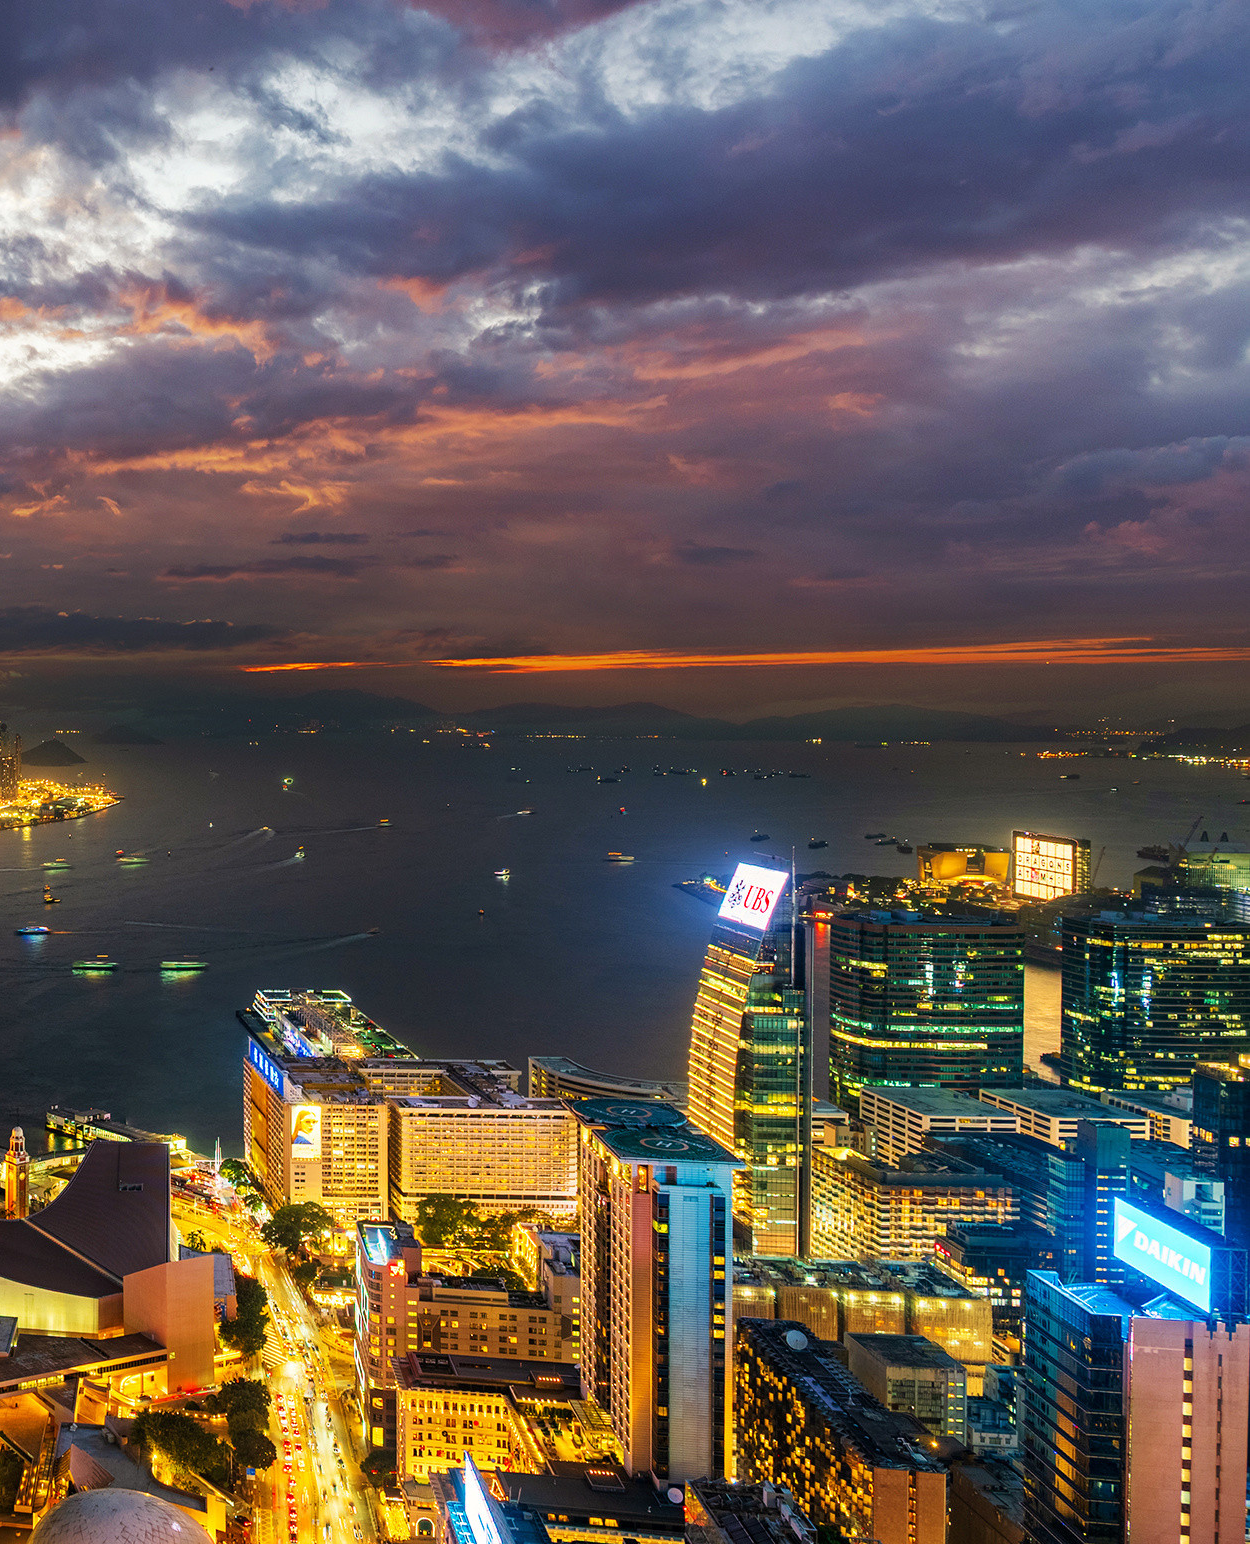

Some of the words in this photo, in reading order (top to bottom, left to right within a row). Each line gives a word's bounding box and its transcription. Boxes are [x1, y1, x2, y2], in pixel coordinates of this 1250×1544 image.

[1017, 854, 1070, 872] DRAGONS
[743, 885, 774, 914] UBS
[1133, 1229, 1206, 1286] DAIKIN
